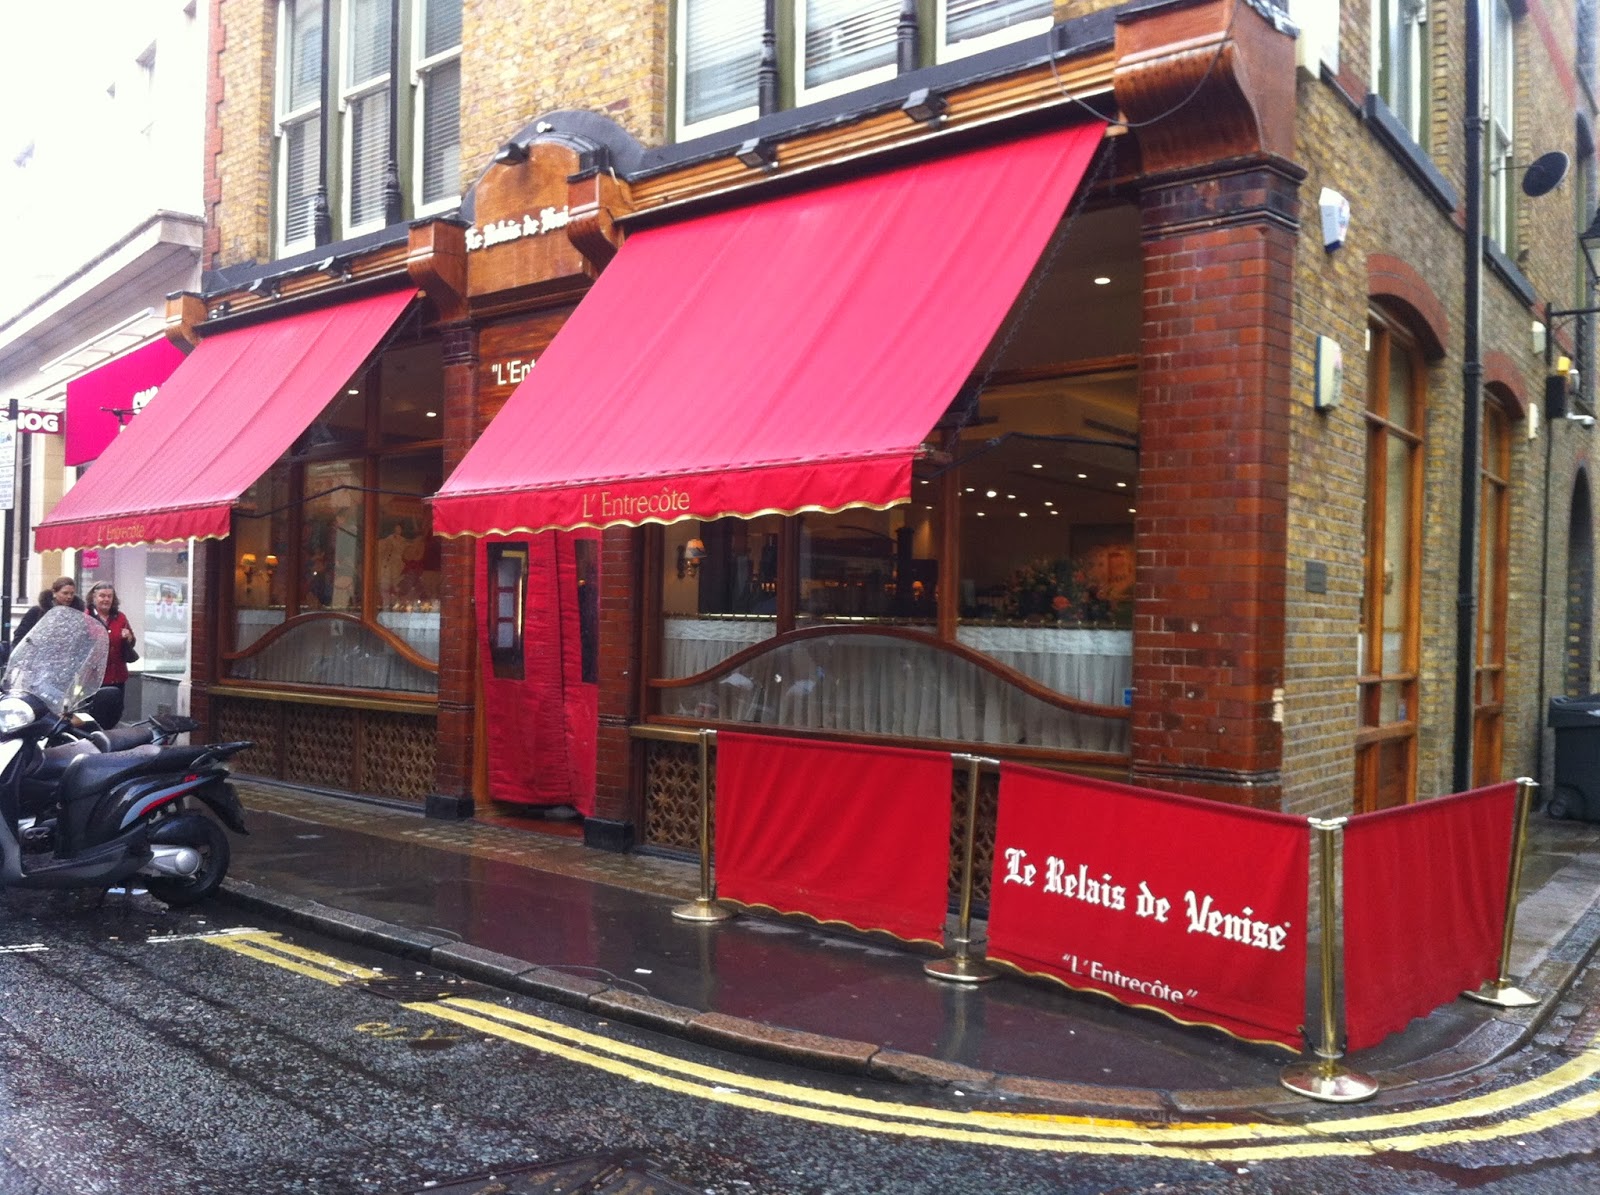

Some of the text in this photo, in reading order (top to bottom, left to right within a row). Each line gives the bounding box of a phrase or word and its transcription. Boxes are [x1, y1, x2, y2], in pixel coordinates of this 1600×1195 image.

[601, 487, 690, 517] Entrecôte
[1003, 847, 1037, 887] Le
[1043, 856, 1127, 910] Relais
[1135, 880, 1171, 922] de
